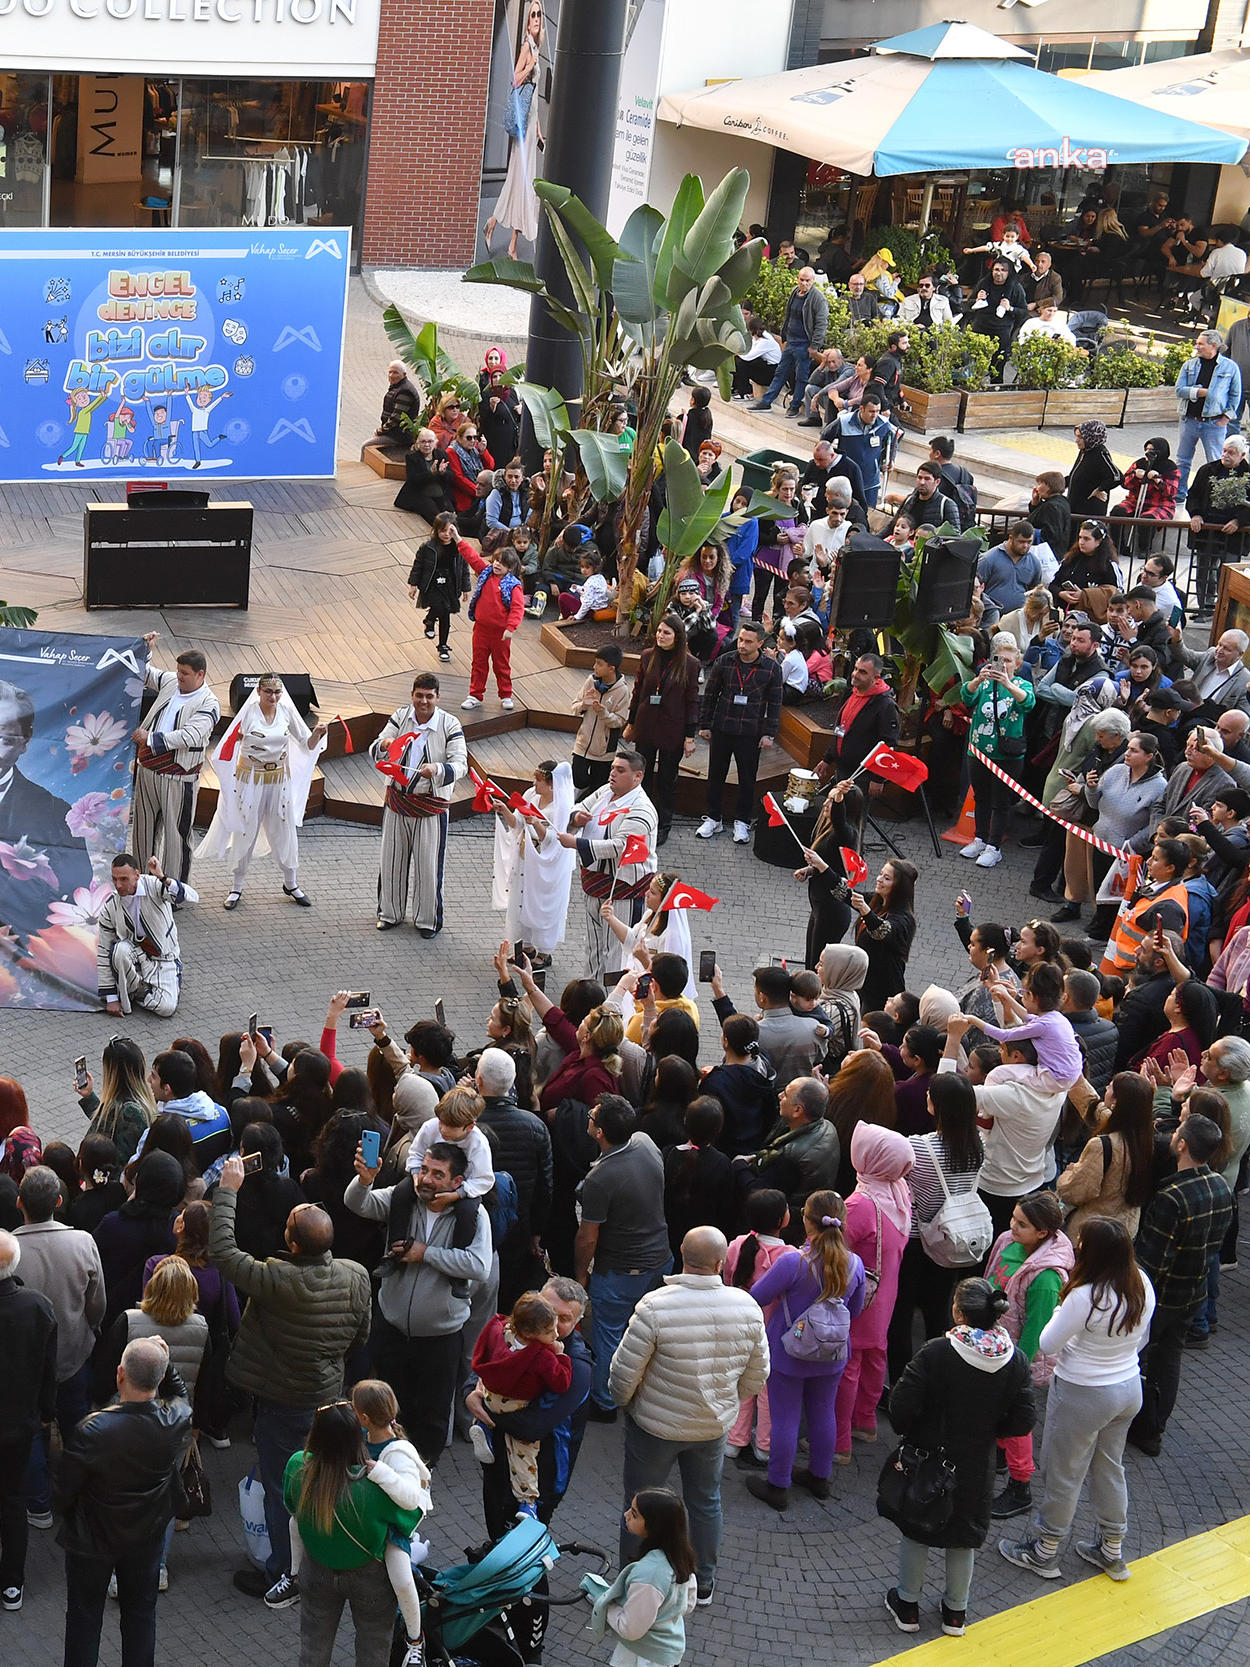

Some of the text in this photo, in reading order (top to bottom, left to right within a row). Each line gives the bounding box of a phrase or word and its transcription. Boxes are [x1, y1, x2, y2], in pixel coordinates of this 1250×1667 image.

[128, 250, 166, 258] BÜYÜKŞEHİR
[251, 242, 276, 259] Vahap
[109, 270, 196, 298] ENGEL
[87, 328, 144, 362] bizi
[66, 361, 227, 401] bir gülme
[40, 646, 67, 664] Vahap
